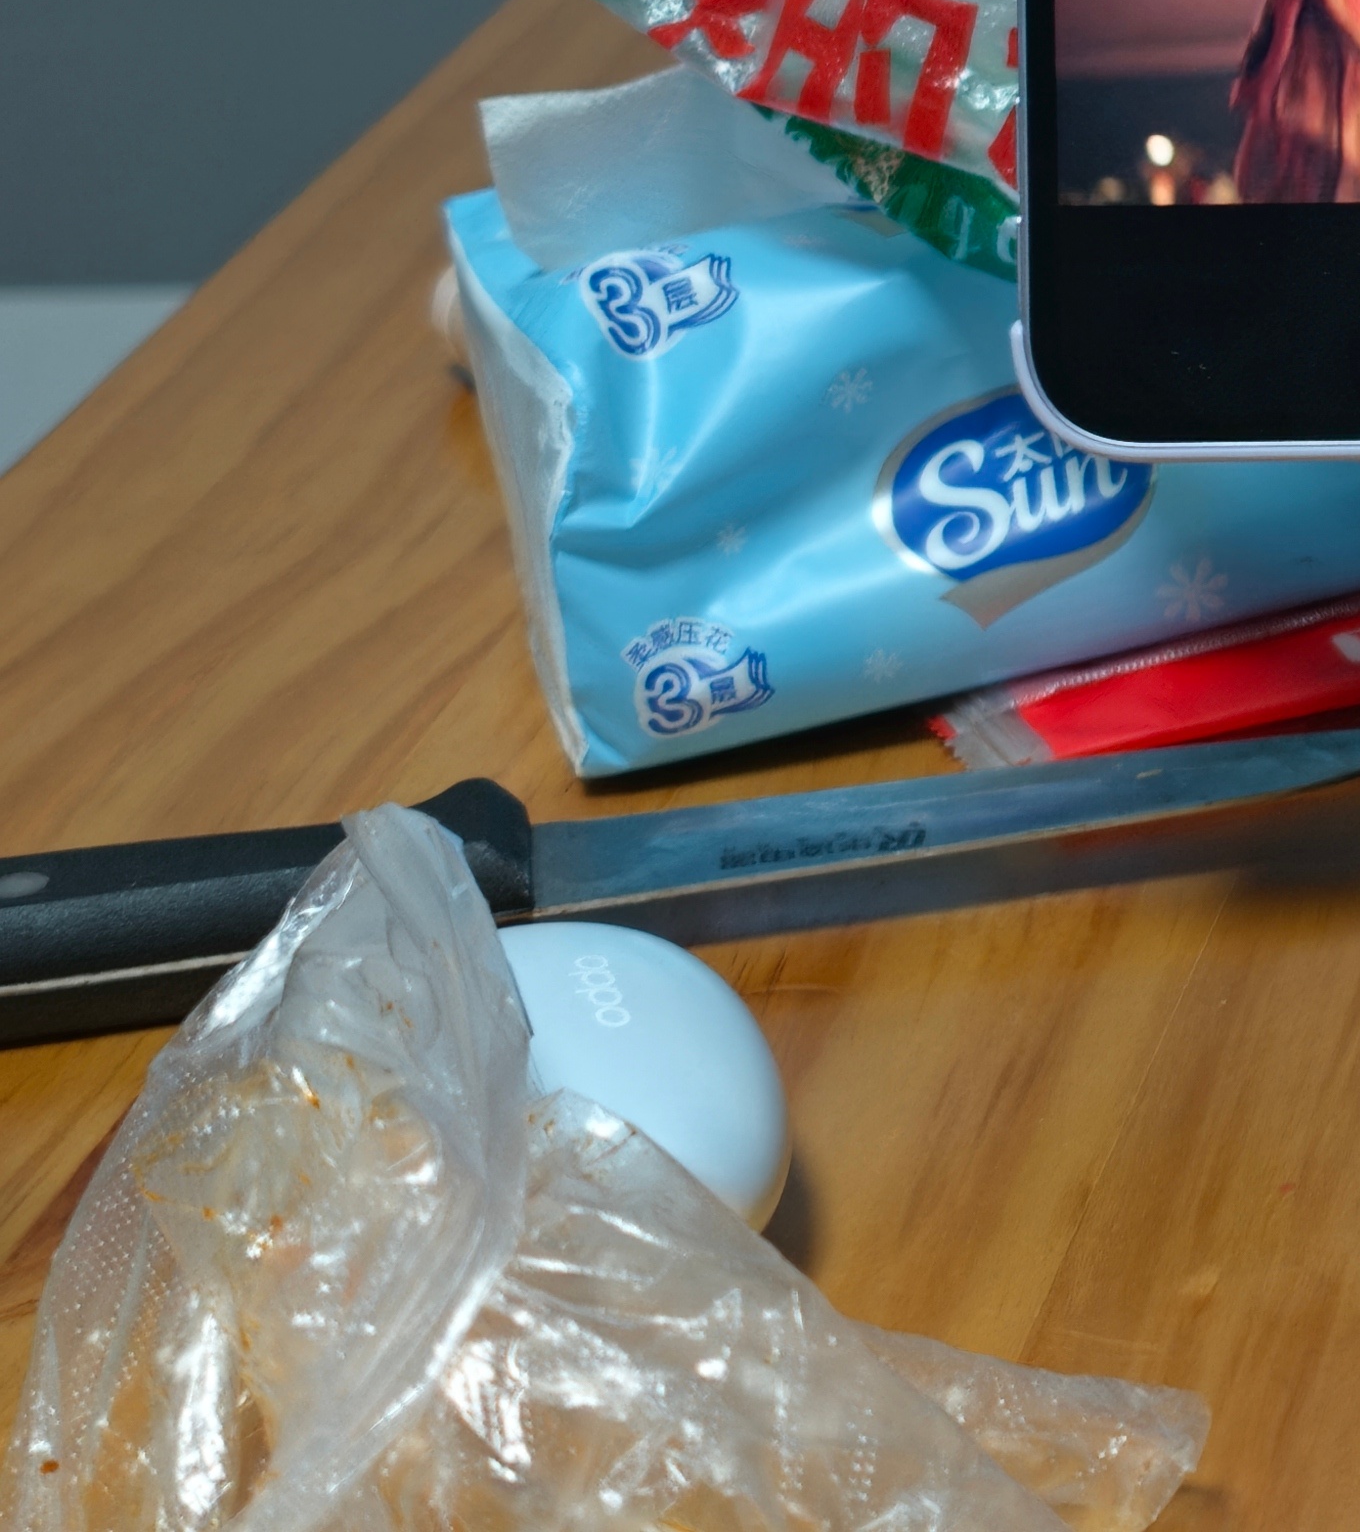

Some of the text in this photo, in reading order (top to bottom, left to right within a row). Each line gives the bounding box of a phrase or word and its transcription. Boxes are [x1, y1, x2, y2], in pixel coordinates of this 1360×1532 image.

[919, 438, 1129, 571] Sun
[626, 620, 733, 671] 柔感压花
